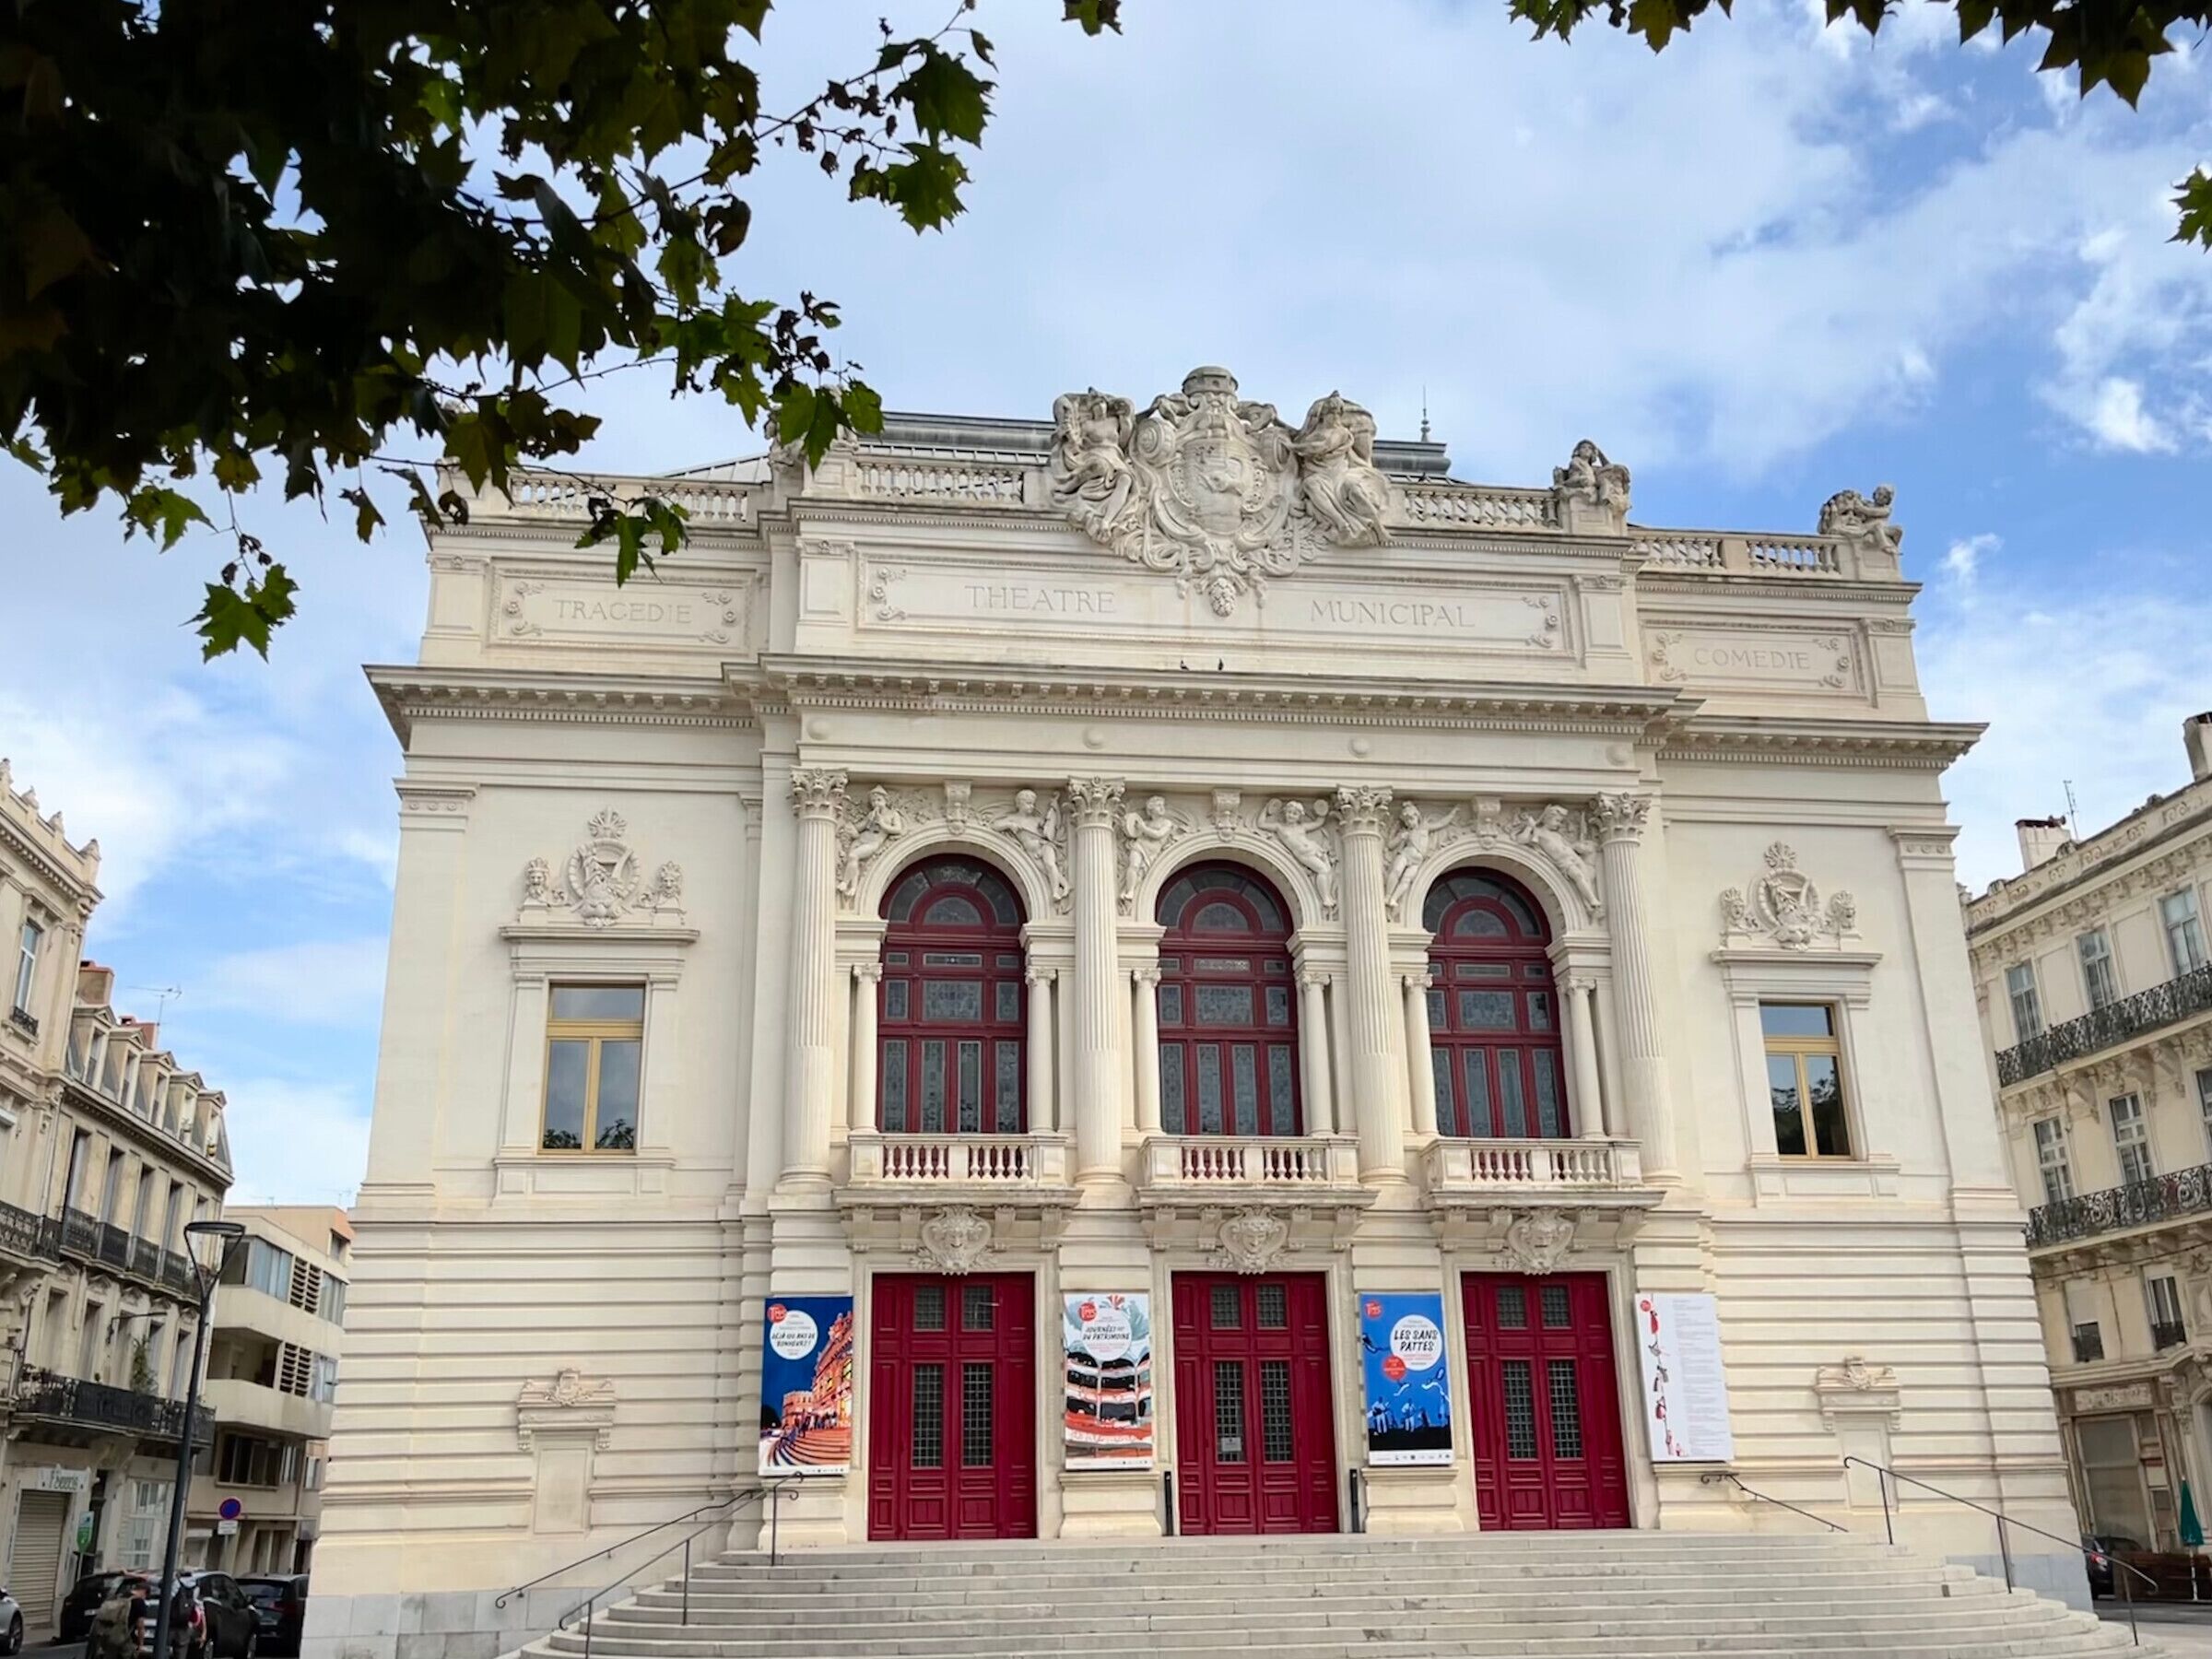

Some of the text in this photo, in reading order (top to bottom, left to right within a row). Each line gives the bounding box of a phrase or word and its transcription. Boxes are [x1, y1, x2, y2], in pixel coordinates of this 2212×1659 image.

[554, 599, 692, 624] TRAGEDIE
[964, 585, 1476, 628] THEATRE MUNICIPAL
[1695, 648, 1810, 669] COMEDIE
[1394, 1329, 1438, 1340] LES SANS
[1400, 1340, 1434, 1351] PATTES
